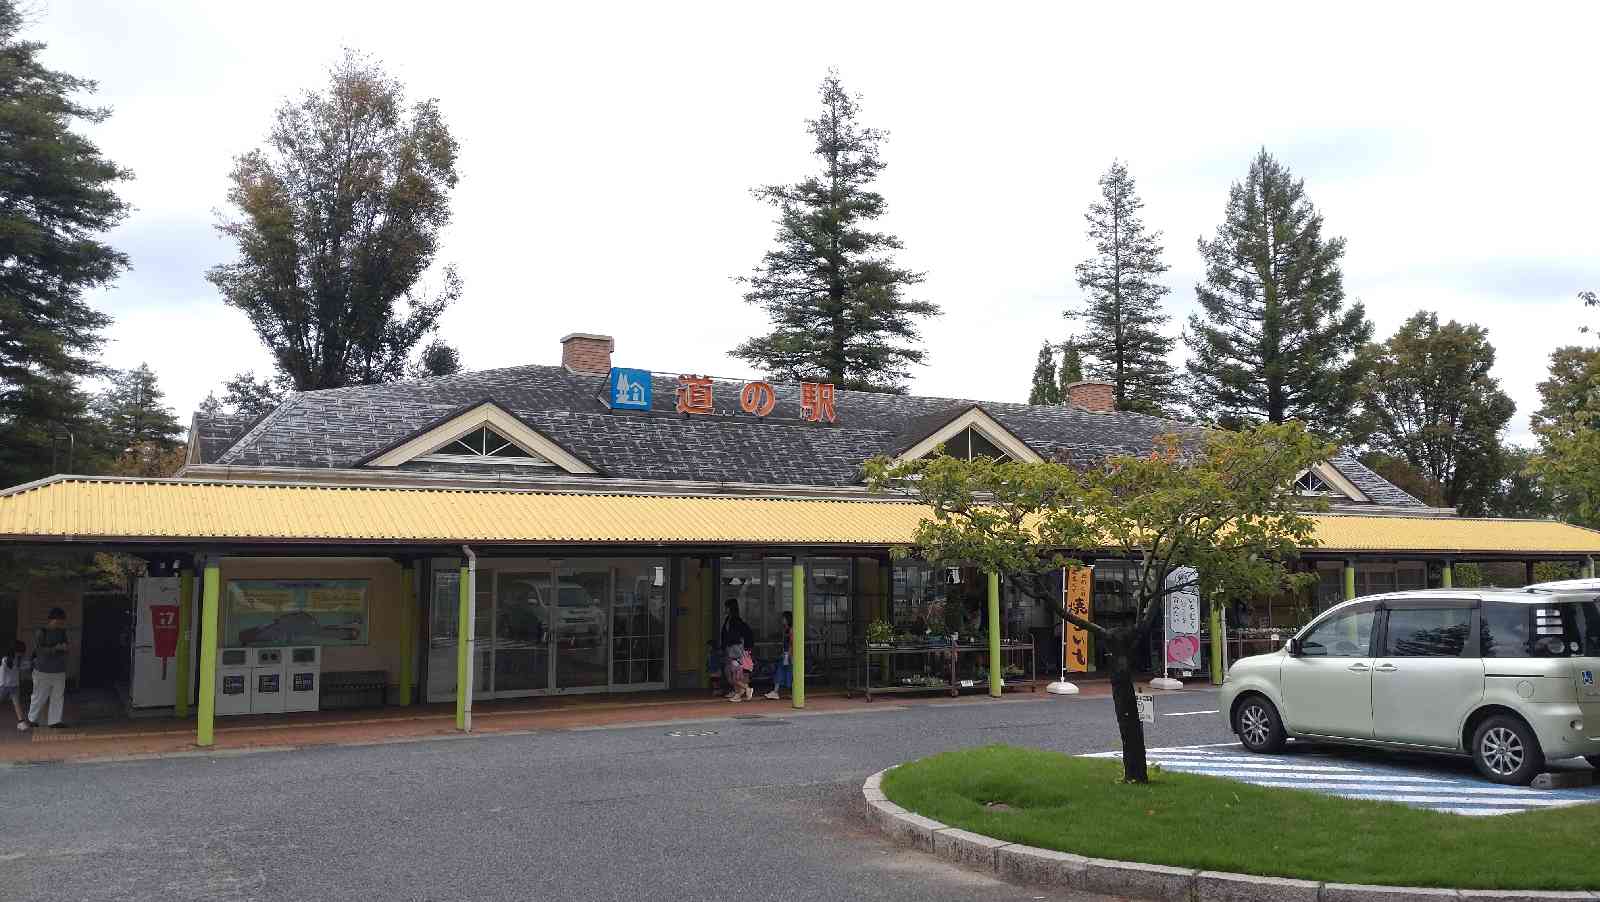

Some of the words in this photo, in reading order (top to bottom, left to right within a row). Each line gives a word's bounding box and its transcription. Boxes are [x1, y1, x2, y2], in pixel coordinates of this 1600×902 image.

[675, 374, 837, 424] 道の駅
[1068, 597, 1089, 665] 焼いも
